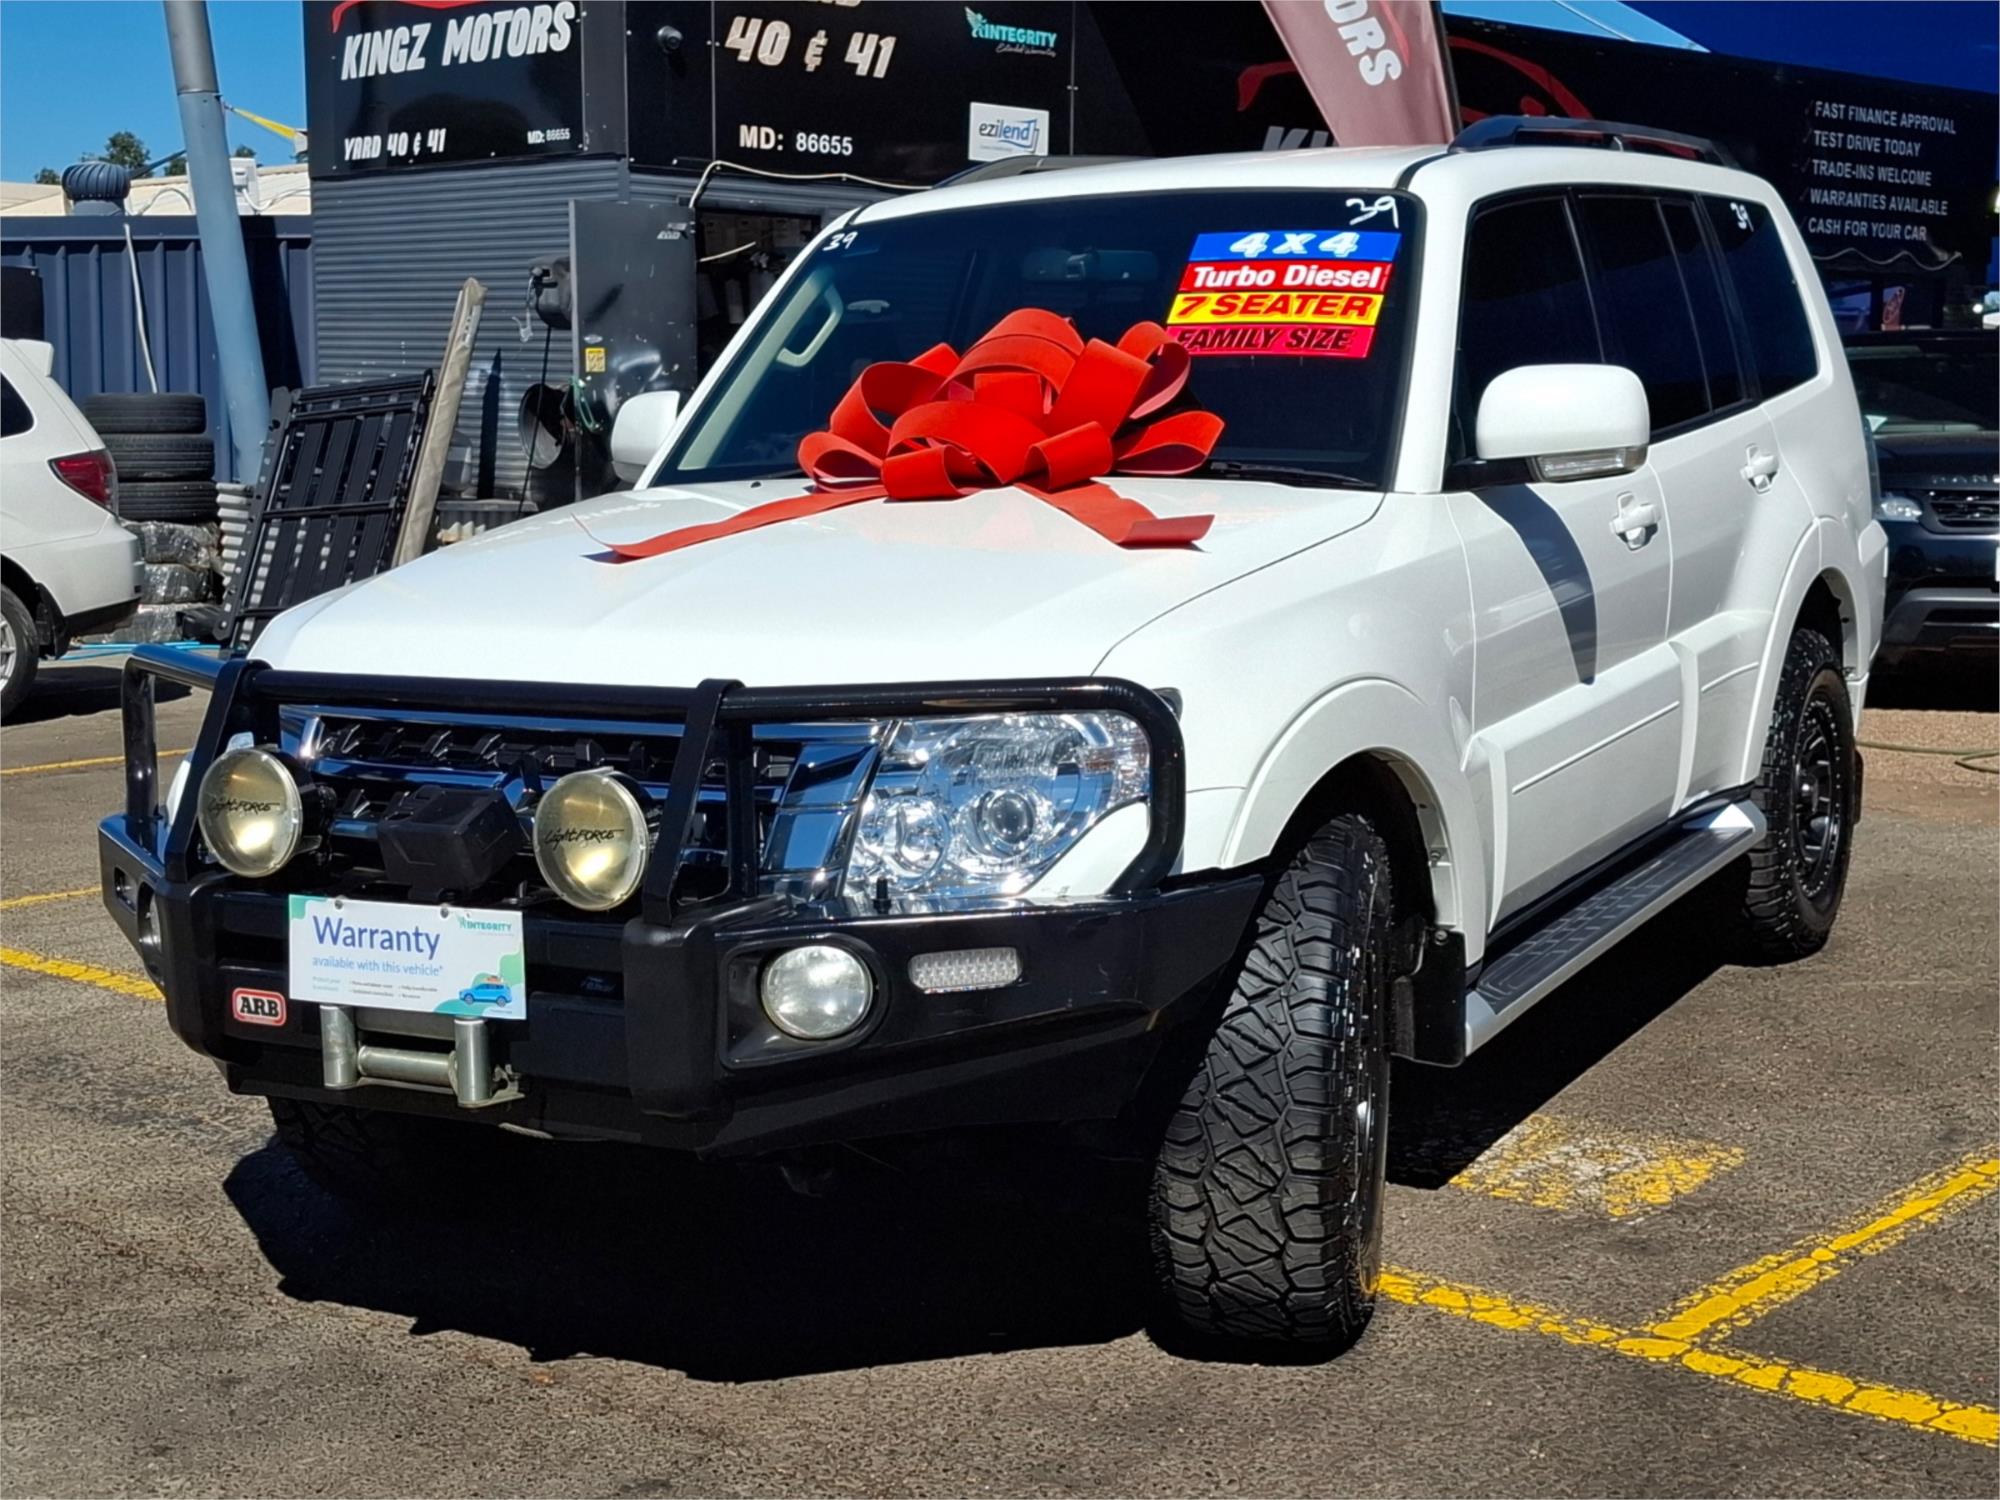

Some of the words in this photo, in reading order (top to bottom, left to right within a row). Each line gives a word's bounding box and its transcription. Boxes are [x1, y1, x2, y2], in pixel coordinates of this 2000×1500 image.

[341, 22, 431, 80] KINGZ
[441, 1, 575, 66] MOTORS
[725, 16, 791, 66] 40
[845, 32, 896, 78] 41
[983, 23, 1057, 48] INTEGRITY
[979, 119, 1034, 141] ezilend
[1815, 101, 1845, 120] FAST
[1848, 105, 1897, 127] FINANCE
[1900, 113, 1956, 135] APPROVAL
[344, 134, 381, 161] YARD
[387, 132, 407, 157] 40
[427, 128, 447, 153] 41
[739, 125, 784, 151] MD:
[796, 132, 853, 156] 86655
[1814, 130, 1844, 149] TEST
[1846, 134, 1881, 153] DRIVE
[1884, 138, 1921, 157] TODAY
[1812, 159, 1874, 181] TRADE-INS
[1877, 166, 1932, 187] WELCOME
[1346, 196, 1399, 229] 39
[1810, 188, 1887, 210] WARRANTIES
[1889, 195, 1948, 216] AVAILABLE
[822, 231, 858, 251] 39
[1808, 217, 1841, 235] CASH
[1843, 220, 1869, 238] FOR
[1871, 222, 1901, 240] YOUR
[1903, 222, 1927, 241] CAR
[1194, 265, 1276, 288] Turbo
[1283, 265, 1382, 288] Diesel
[1177, 296, 1210, 318] 7
[1211, 294, 1375, 319] SEATER
[1177, 328, 1282, 350] FAMILY
[1287, 328, 1355, 350] SIZE
[313, 915, 440, 960] Warranty
[466, 920, 512, 932] INTEGRITY
[312, 956, 355, 969] available
[356, 959, 380, 972] with
[382, 961, 401, 974] this
[240, 995, 279, 1018] ARB
